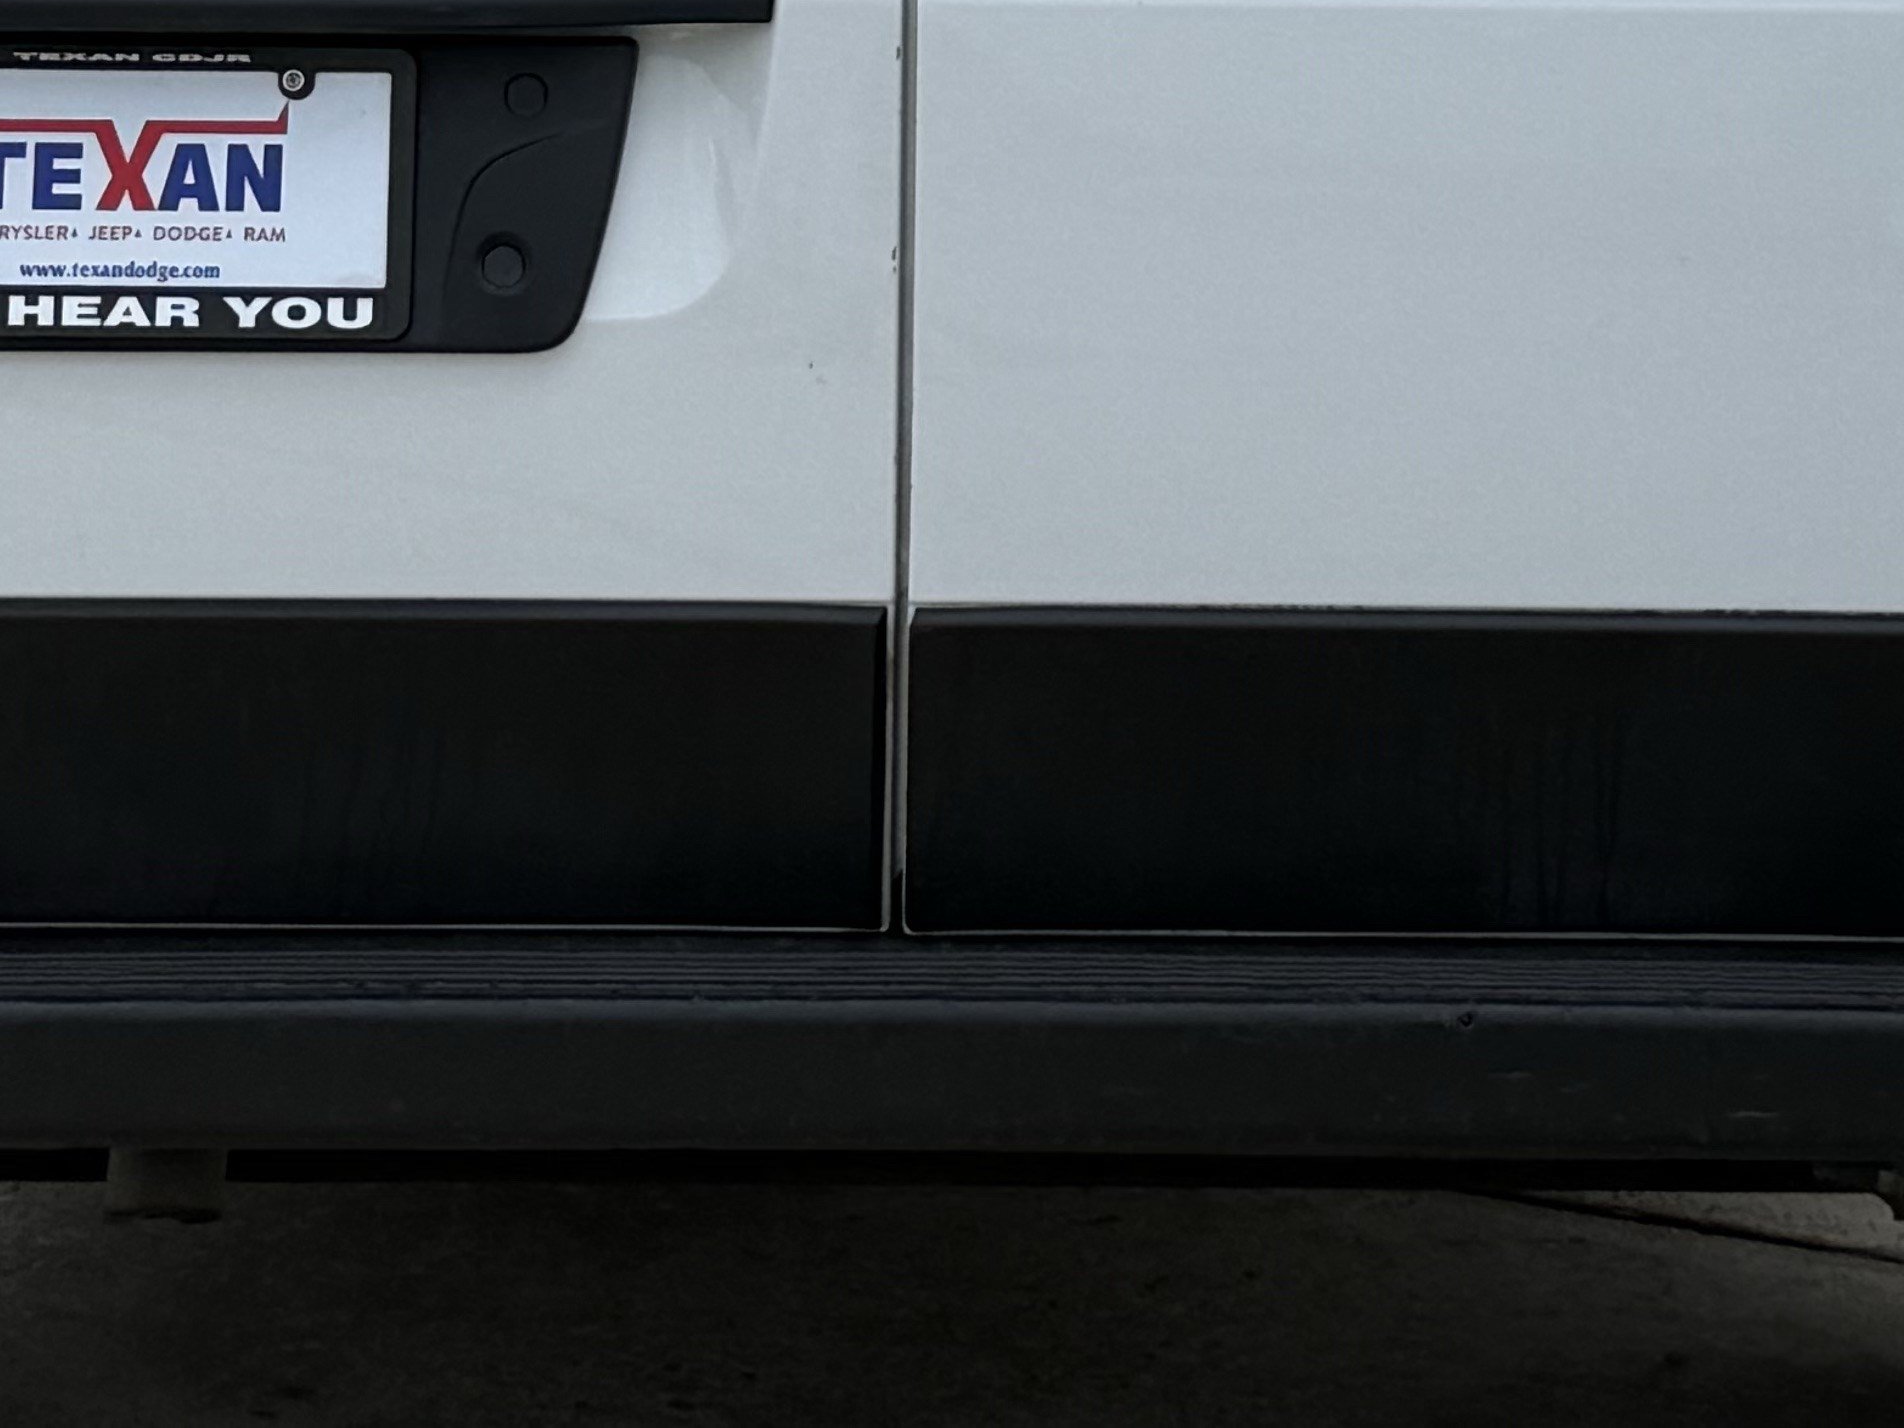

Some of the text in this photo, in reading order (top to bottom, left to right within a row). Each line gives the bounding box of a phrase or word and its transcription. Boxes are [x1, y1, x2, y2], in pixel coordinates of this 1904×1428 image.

[13, 51, 251, 63] TEXAN CDJR
[88, 225, 133, 241] JEEP
[152, 226, 223, 242] DODGE
[243, 227, 287, 243] RAM
[19, 261, 221, 282] www.texandodge.com
[7, 295, 200, 328] HEAR
[222, 296, 374, 329] YOU
